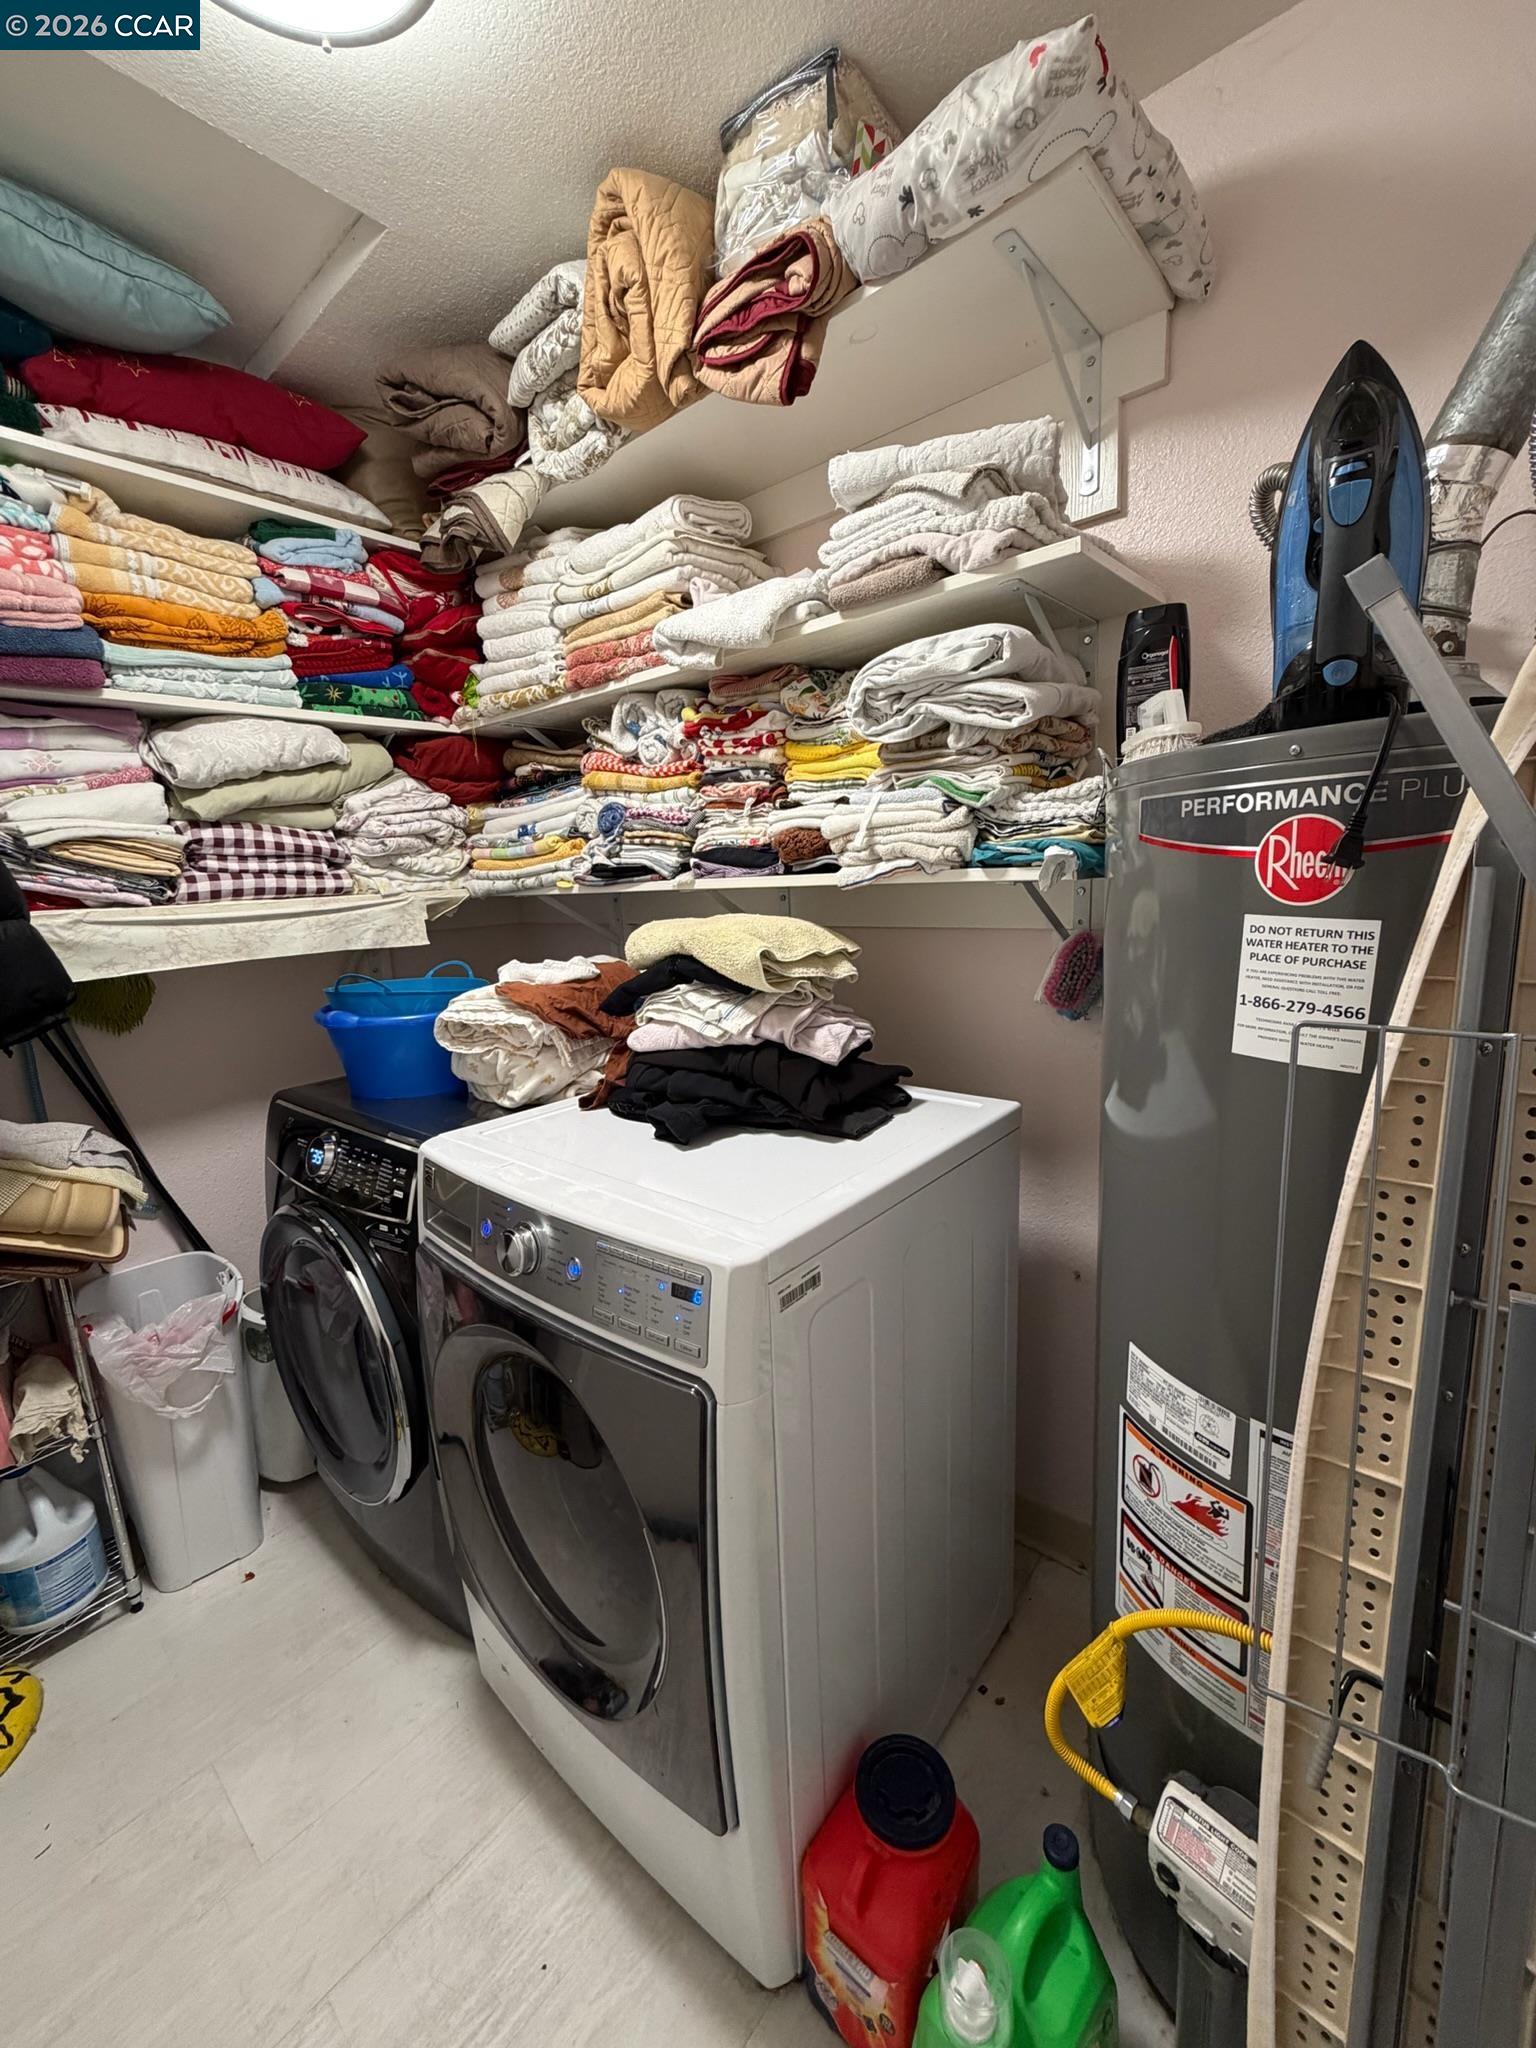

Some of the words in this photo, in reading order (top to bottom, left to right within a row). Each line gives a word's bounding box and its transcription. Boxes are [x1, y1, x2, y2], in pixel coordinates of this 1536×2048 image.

[1181, 780, 1389, 818] PERFORMANCE
[1401, 774, 1467, 801] PLU
[1245, 938, 1283, 950] WATER
[1285, 941, 1329, 953] HEATER
[1331, 944, 1349, 954] TO
[1351, 945, 1375, 955] THE
[1249, 924, 1266, 934] DO
[1268, 926, 1293, 936] NOT
[1295, 927, 1344, 939] RETURN
[1346, 930, 1376, 941] THIS
[1249, 952, 1282, 963] PLACE
[1284, 955, 1300, 965] OF
[1302, 957, 1368, 970] PURCHASE
[1239, 994, 1366, 1021] 1-866-279-4566
[1157, 1455, 1204, 1489] WARNING
[1159, 1555, 1197, 1590] DANGER
[1188, 1808, 1211, 1830] STATUS
[1210, 1827, 1231, 1846] LIGHT
